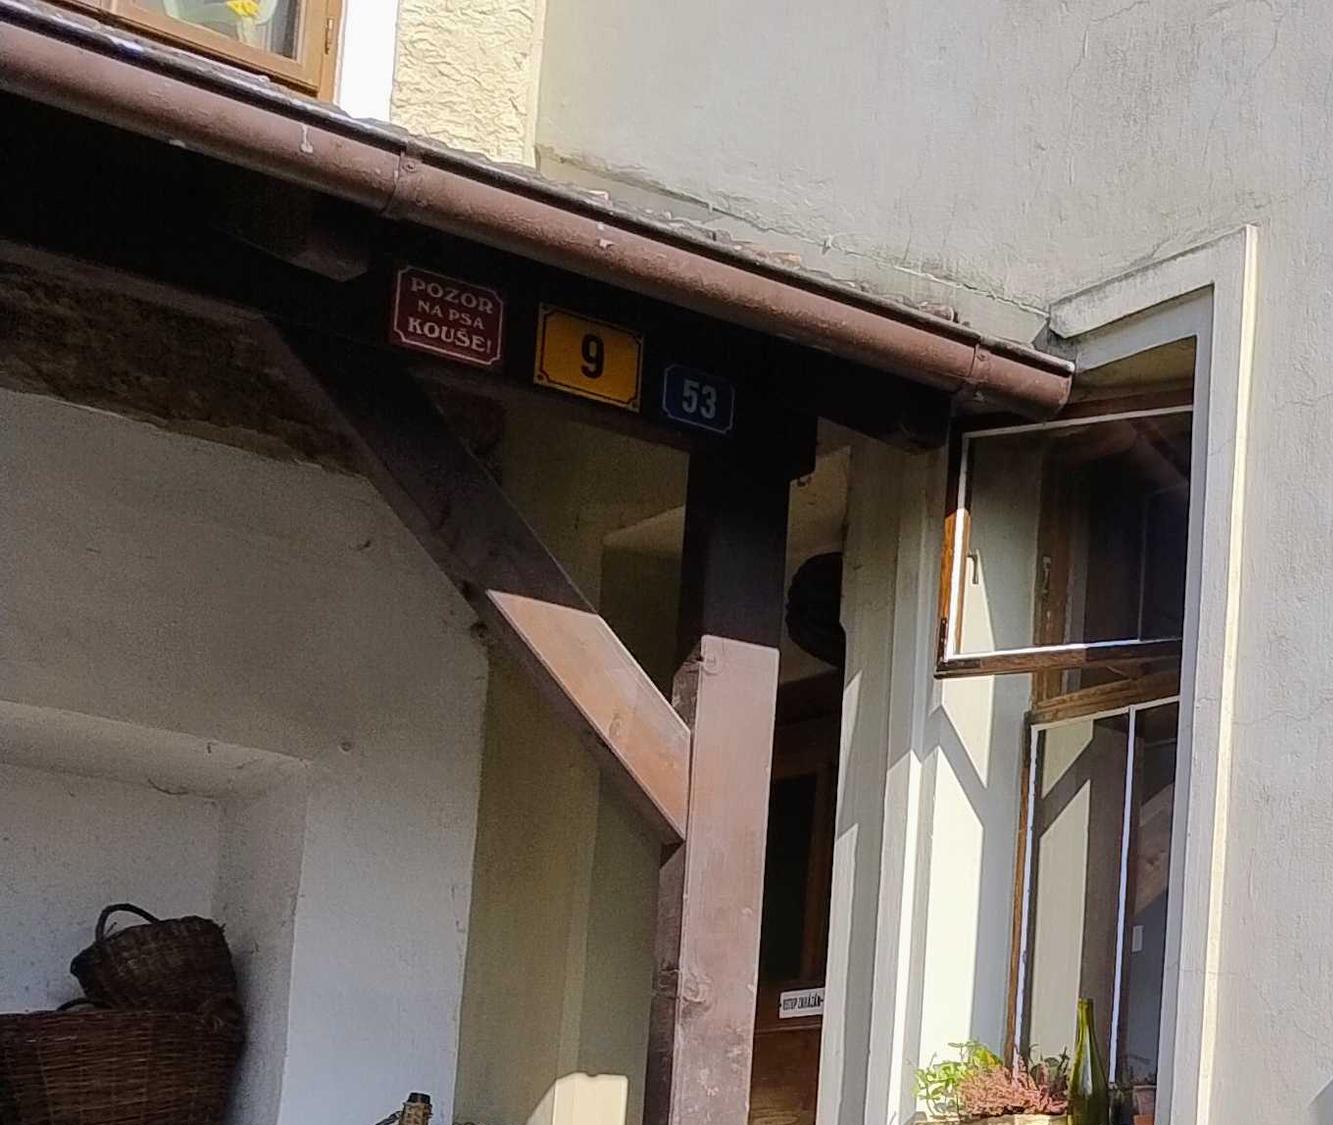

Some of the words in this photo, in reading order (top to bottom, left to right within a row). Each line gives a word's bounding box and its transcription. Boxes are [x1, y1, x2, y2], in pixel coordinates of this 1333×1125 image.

[410, 277, 494, 314] POZOR
[416, 299, 443, 319] NA
[448, 308, 485, 330] PSA
[407, 316, 493, 355] KOUŠE!
[580, 333, 605, 379] 9
[682, 379, 718, 420] 53
